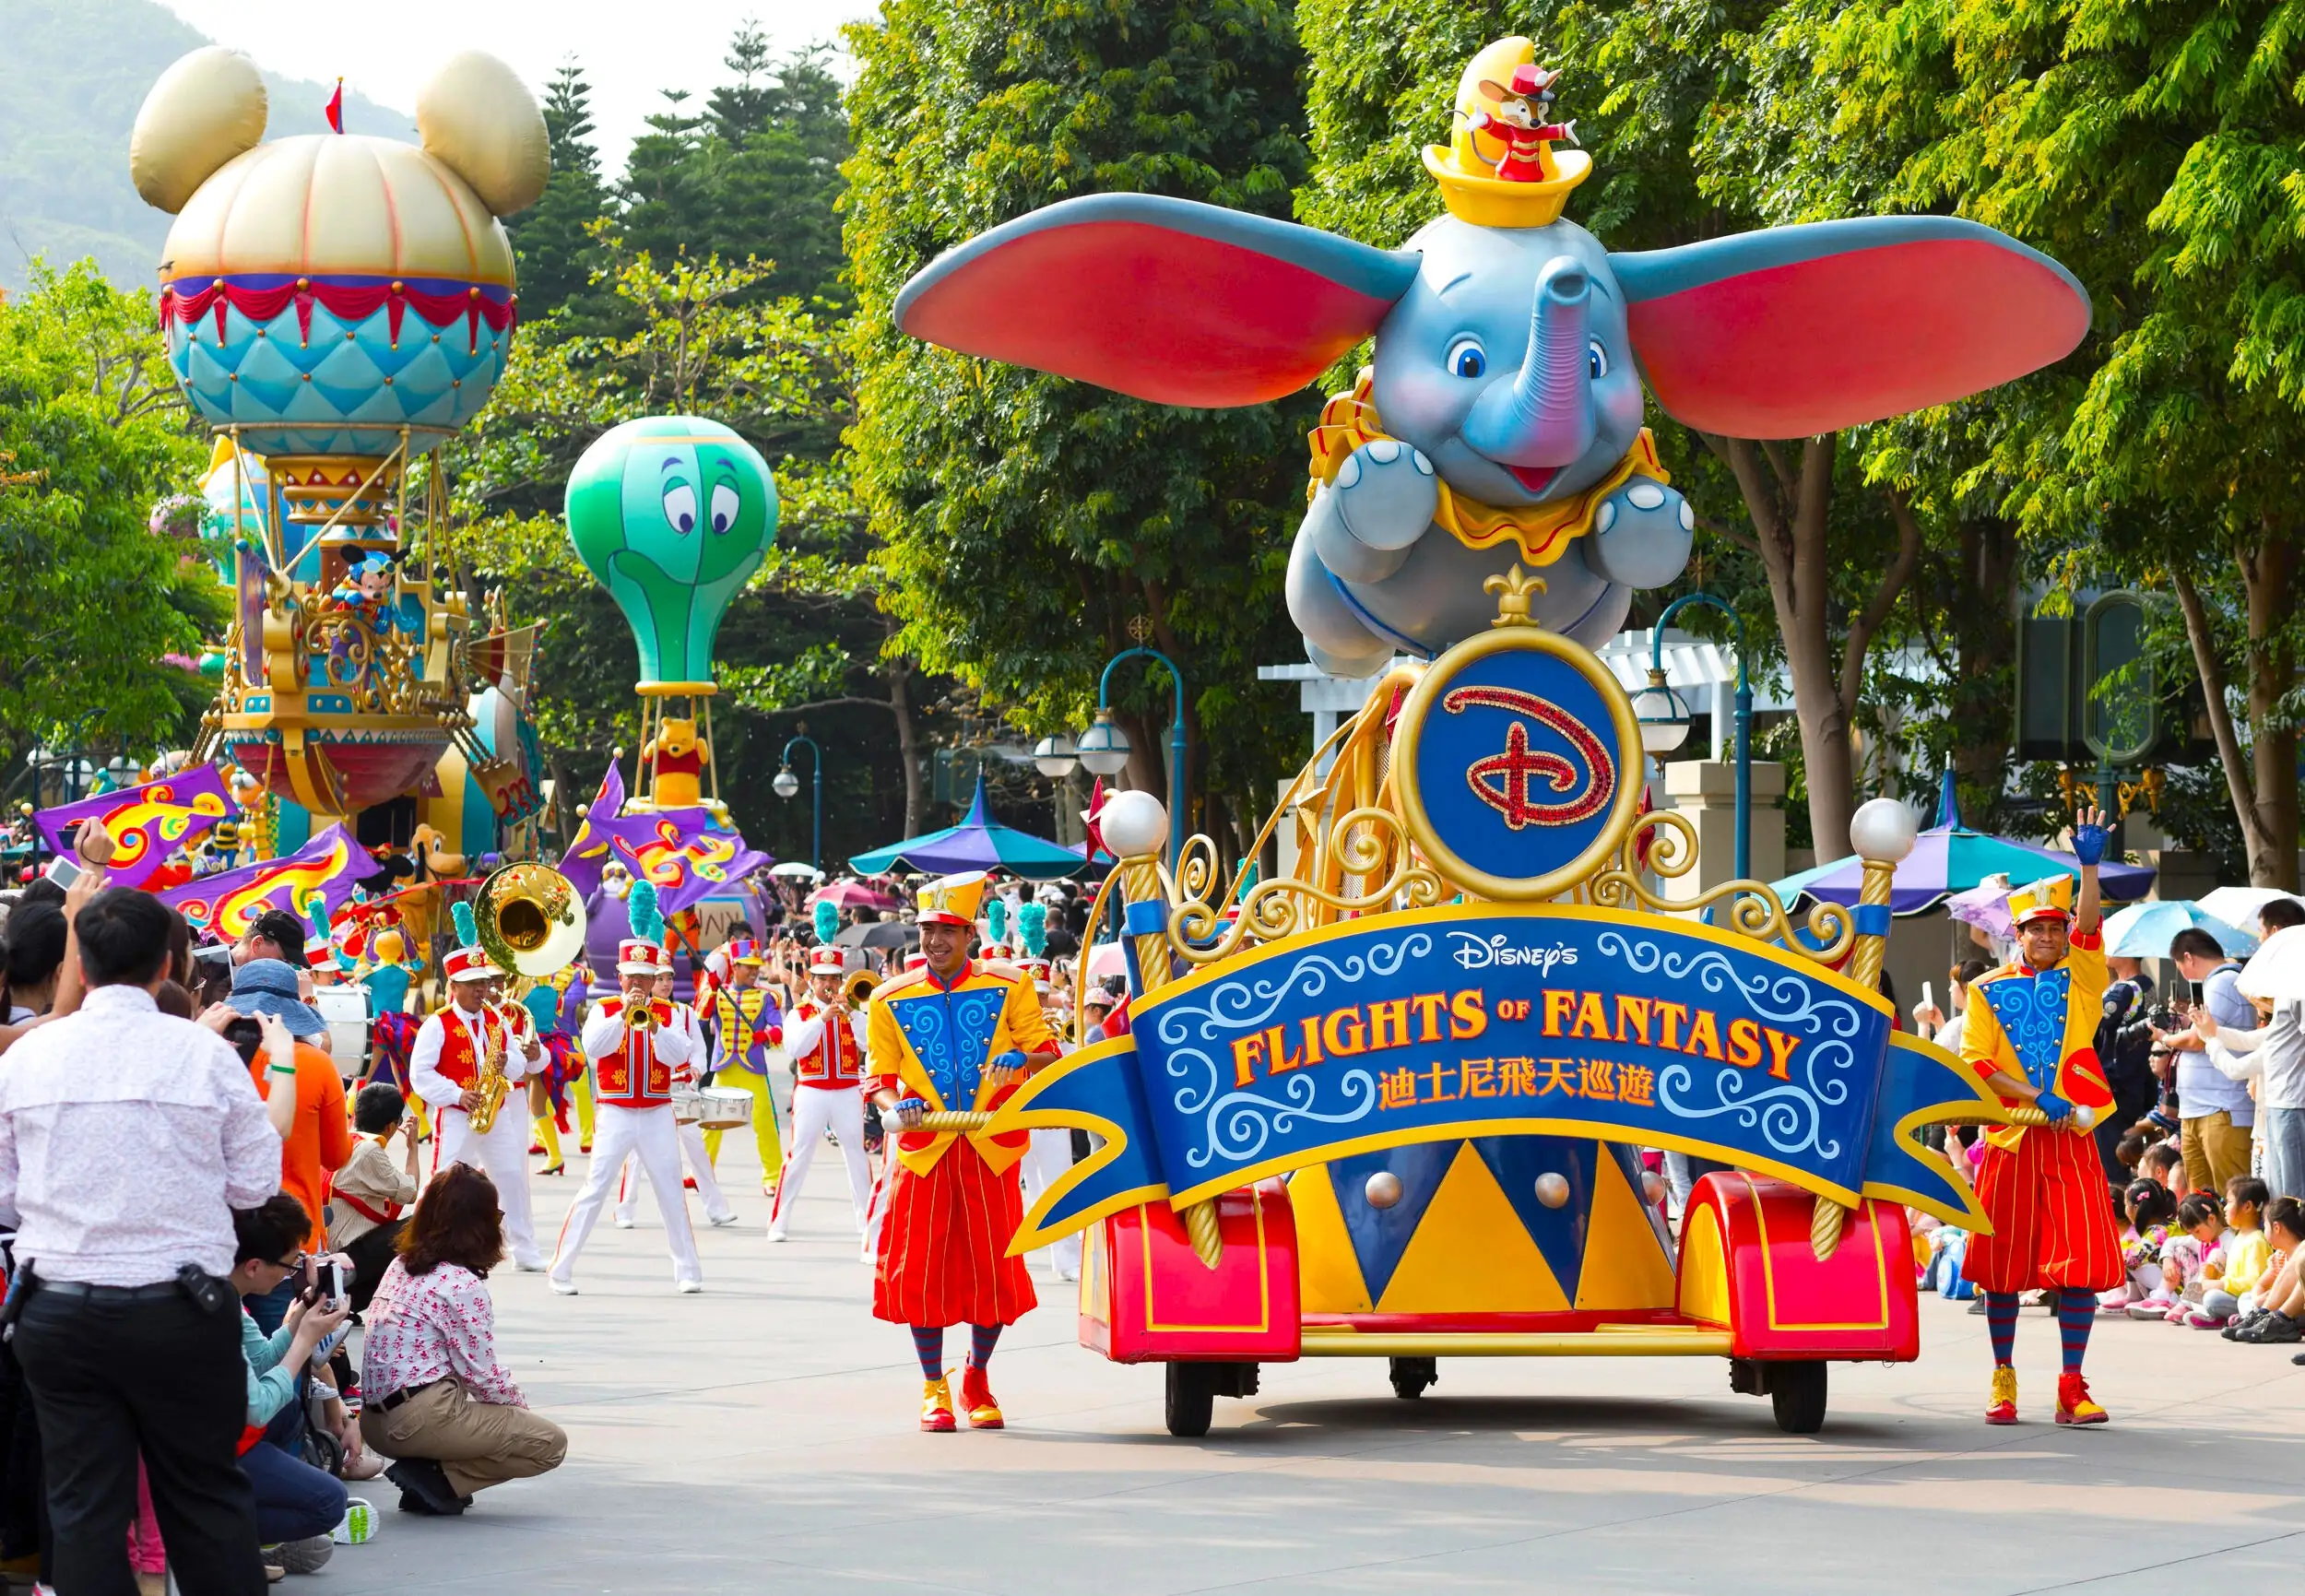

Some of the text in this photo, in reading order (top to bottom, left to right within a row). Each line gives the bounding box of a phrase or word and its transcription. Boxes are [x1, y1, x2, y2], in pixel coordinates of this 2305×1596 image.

[1443, 685, 1615, 830] D
[1229, 987, 1802, 1089] FLIGHTS OF FANTASY
[1378, 1056, 1656, 1111] 迪士尼飛天巡遊
